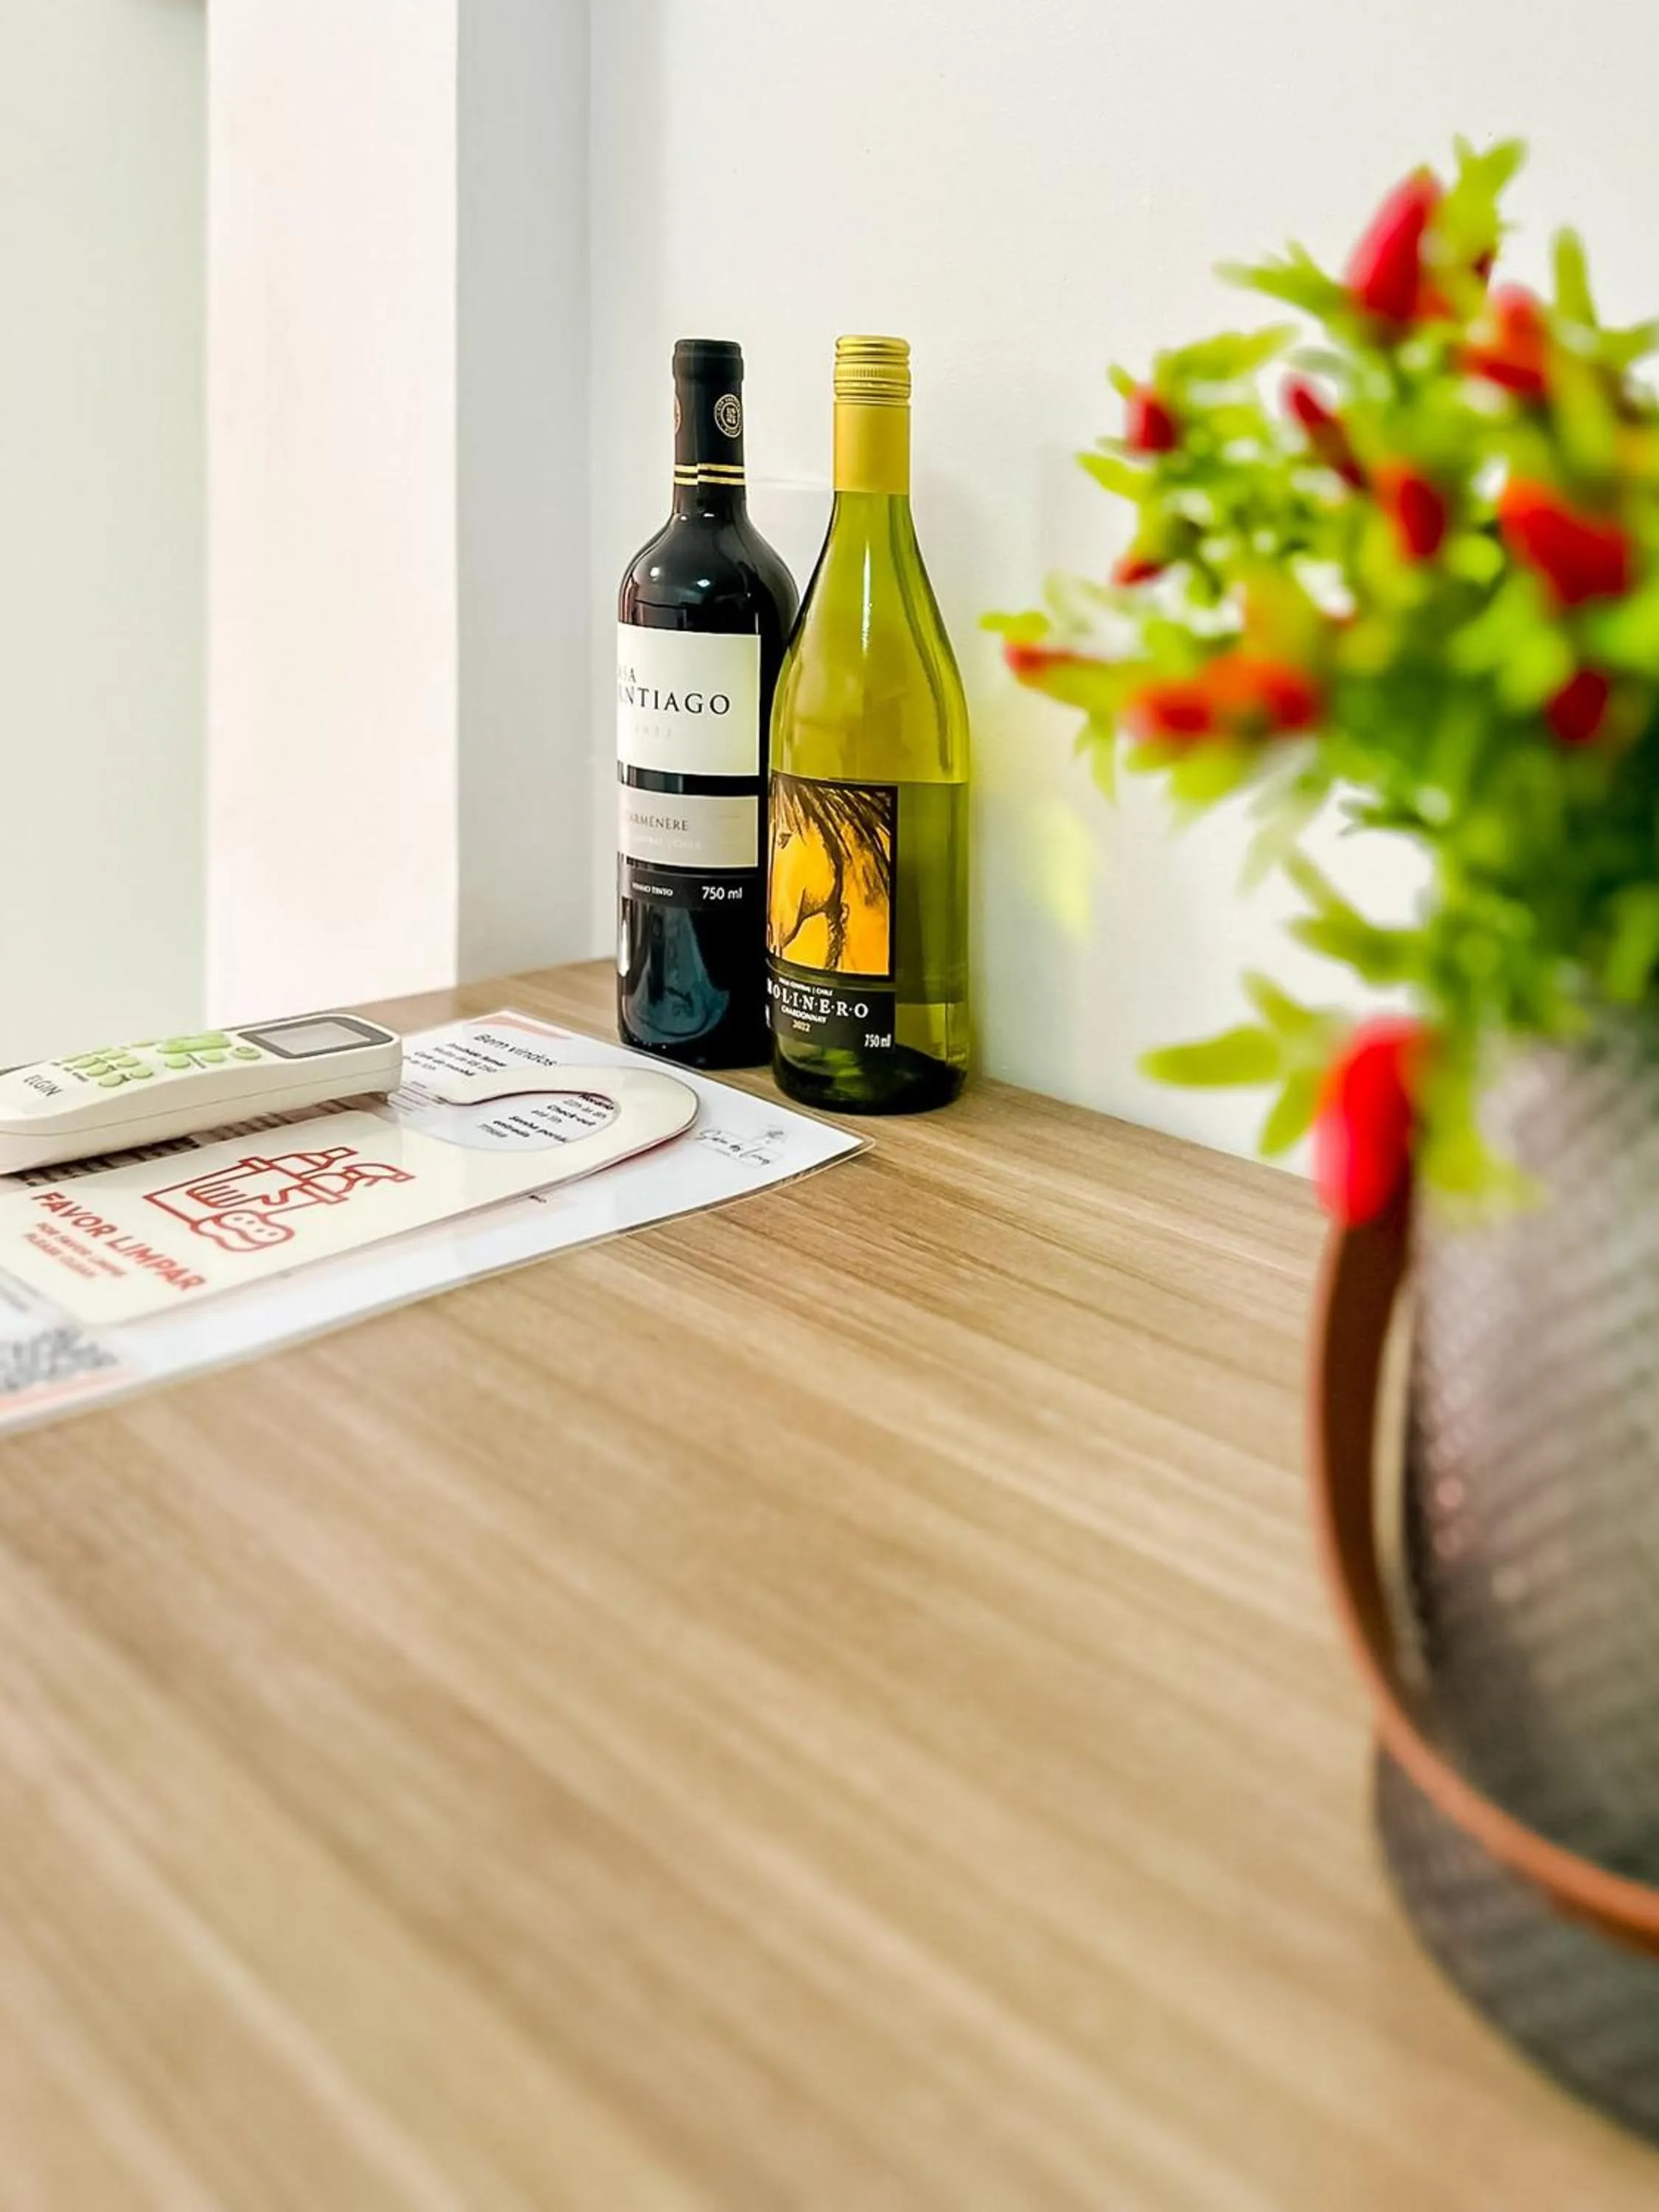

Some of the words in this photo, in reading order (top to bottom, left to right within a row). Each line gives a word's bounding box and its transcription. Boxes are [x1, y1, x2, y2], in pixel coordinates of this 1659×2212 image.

[702, 886, 725, 900] 750
[727, 887, 742, 900] ml
[863, 1034, 880, 1047] 750
[23, 1074, 63, 1097] ELGIN
[30, 1191, 118, 1239] FAVOR
[105, 1236, 206, 1291] LIMPAR
